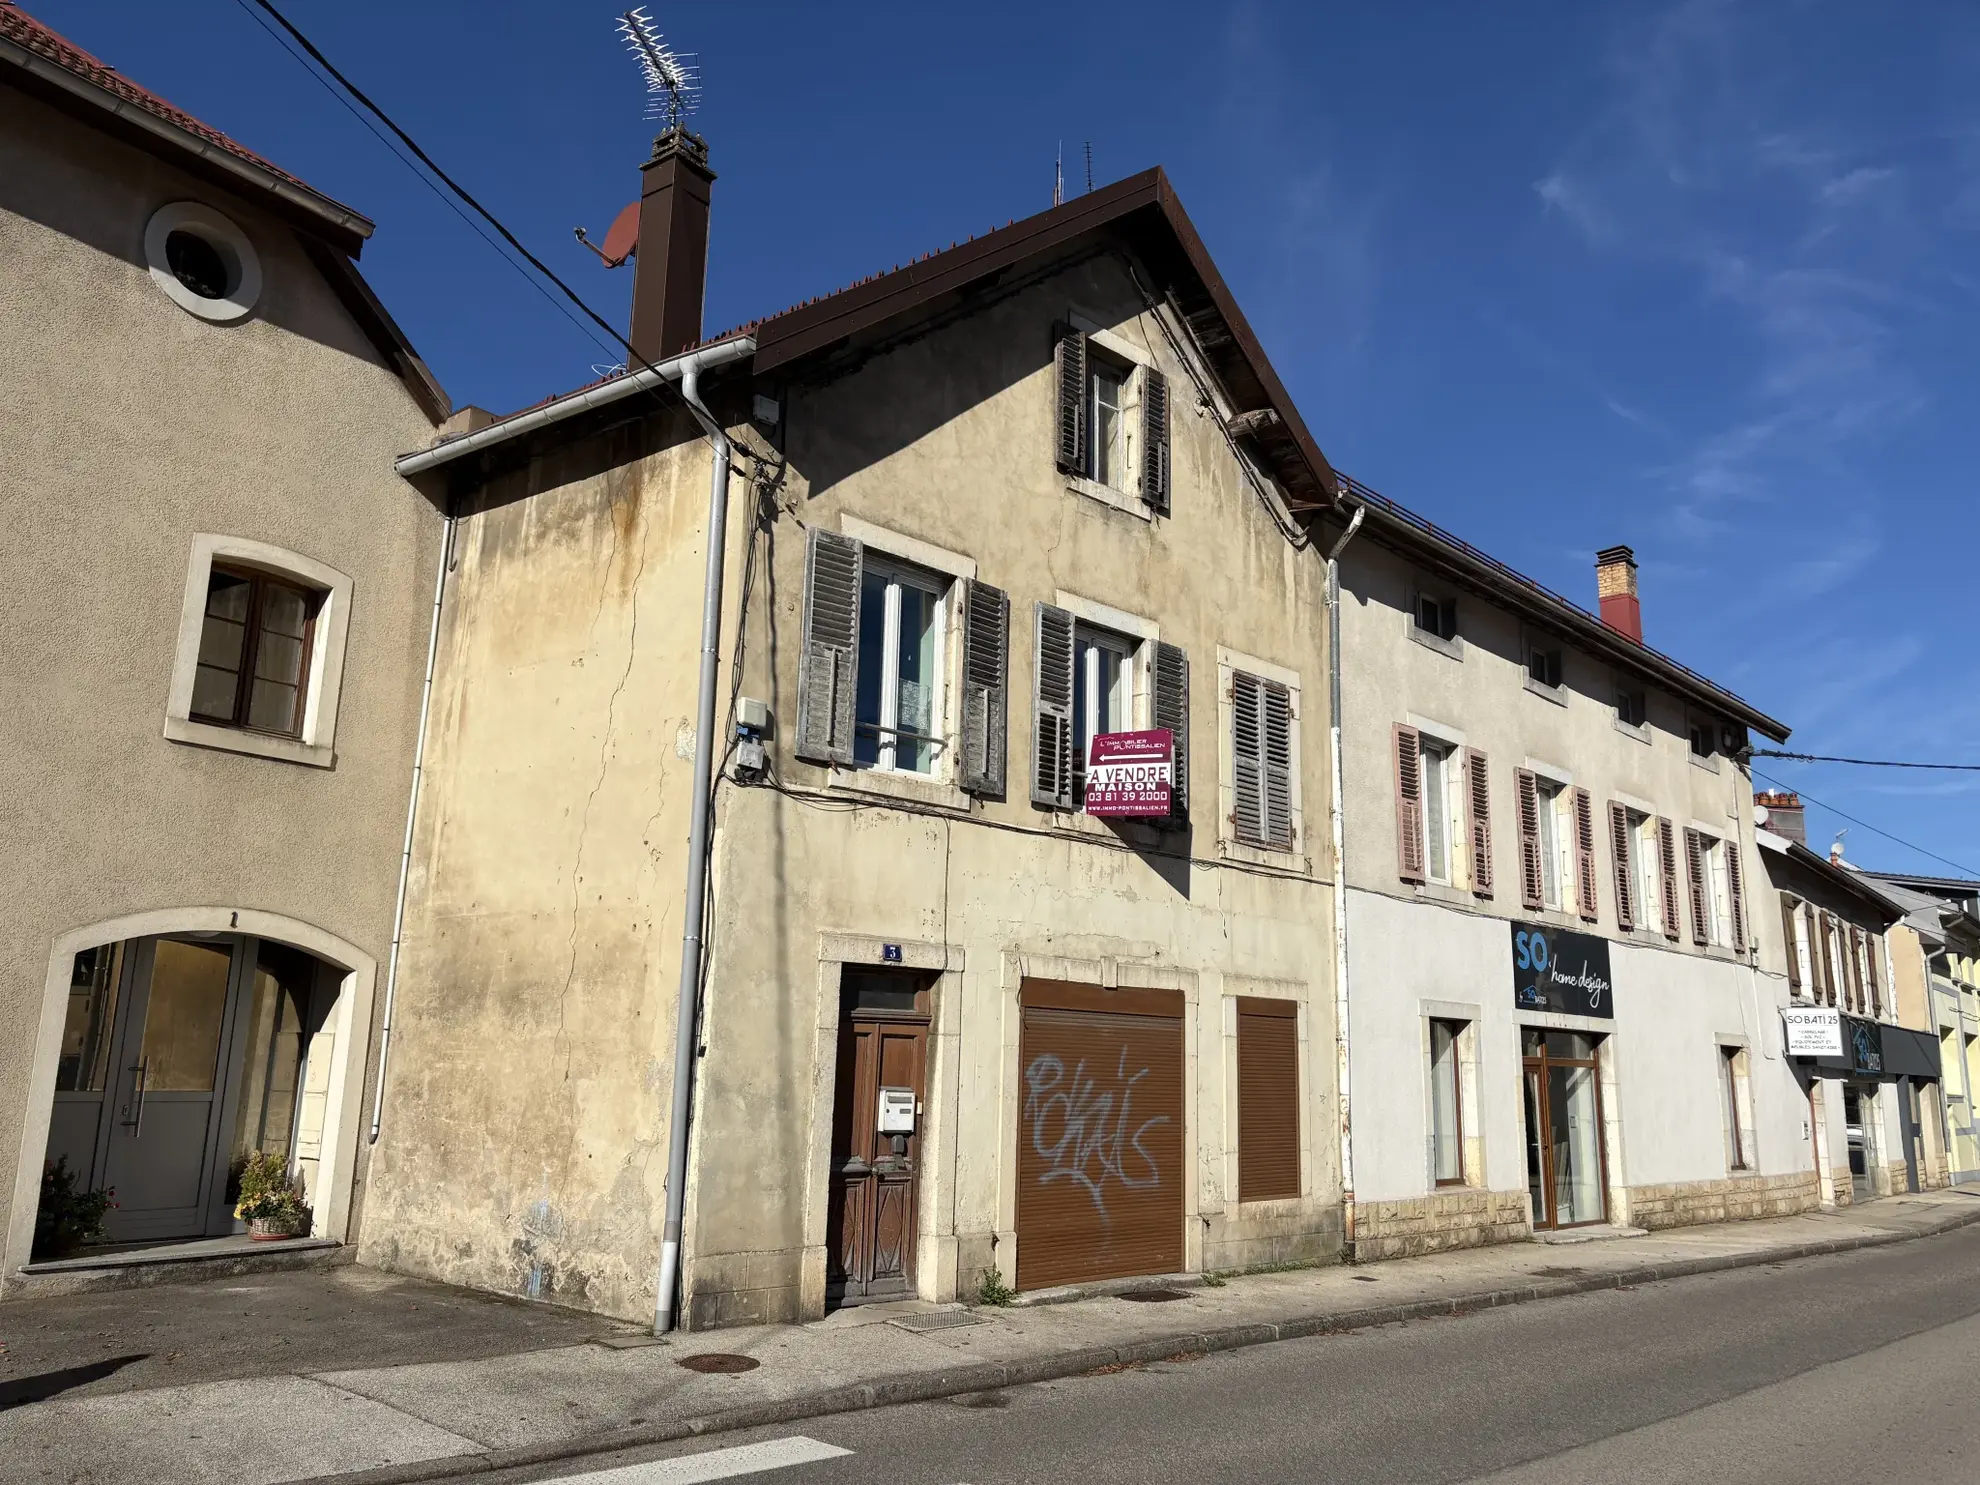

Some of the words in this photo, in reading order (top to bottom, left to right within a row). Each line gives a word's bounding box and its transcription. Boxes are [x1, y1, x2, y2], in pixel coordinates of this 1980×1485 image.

[1090, 769, 1099, 782] A
[1106, 767, 1167, 782] VENDRE
[1095, 782, 1156, 791] MAISON
[1088, 792, 1101, 801] 03
[1105, 792, 1117, 801] 81
[1122, 792, 1135, 801] 39
[1139, 791, 1167, 801] 2000
[1516, 931, 1548, 972] SO
[1578, 960, 1610, 1009] design
[1787, 1015, 1802, 1024] SO
[1828, 1015, 1838, 1024] 25
